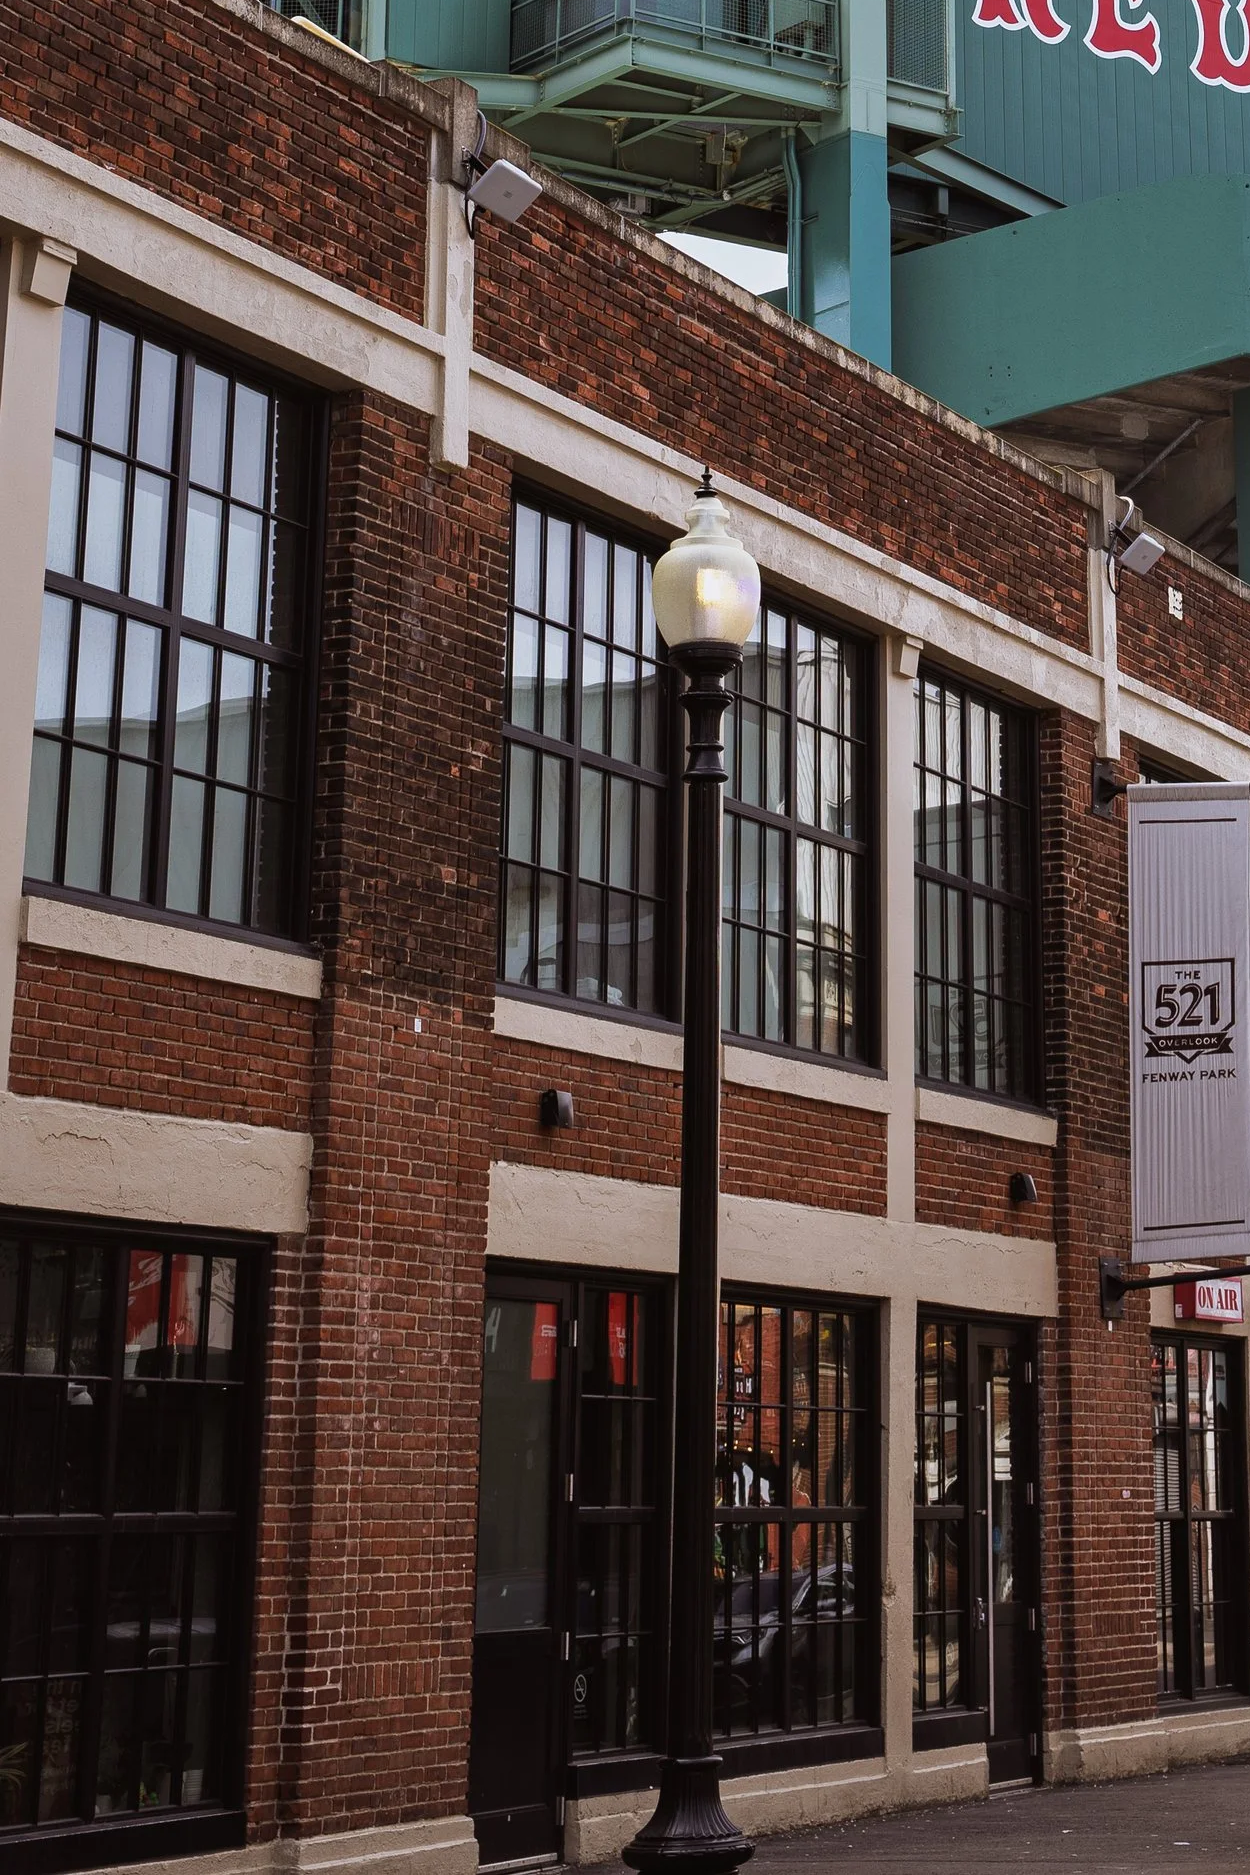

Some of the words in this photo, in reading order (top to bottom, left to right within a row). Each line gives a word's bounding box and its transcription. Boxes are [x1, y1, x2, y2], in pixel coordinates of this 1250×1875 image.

[1175, 970, 1201, 980] THE
[1155, 981, 1220, 1028] 521
[1158, 1036, 1219, 1048] OVERLOOK
[1142, 1070, 1195, 1084] FENWAY
[1200, 1068, 1237, 1080] PARK
[1198, 1286, 1214, 1309] ON
[1216, 1288, 1239, 1311] AIR
